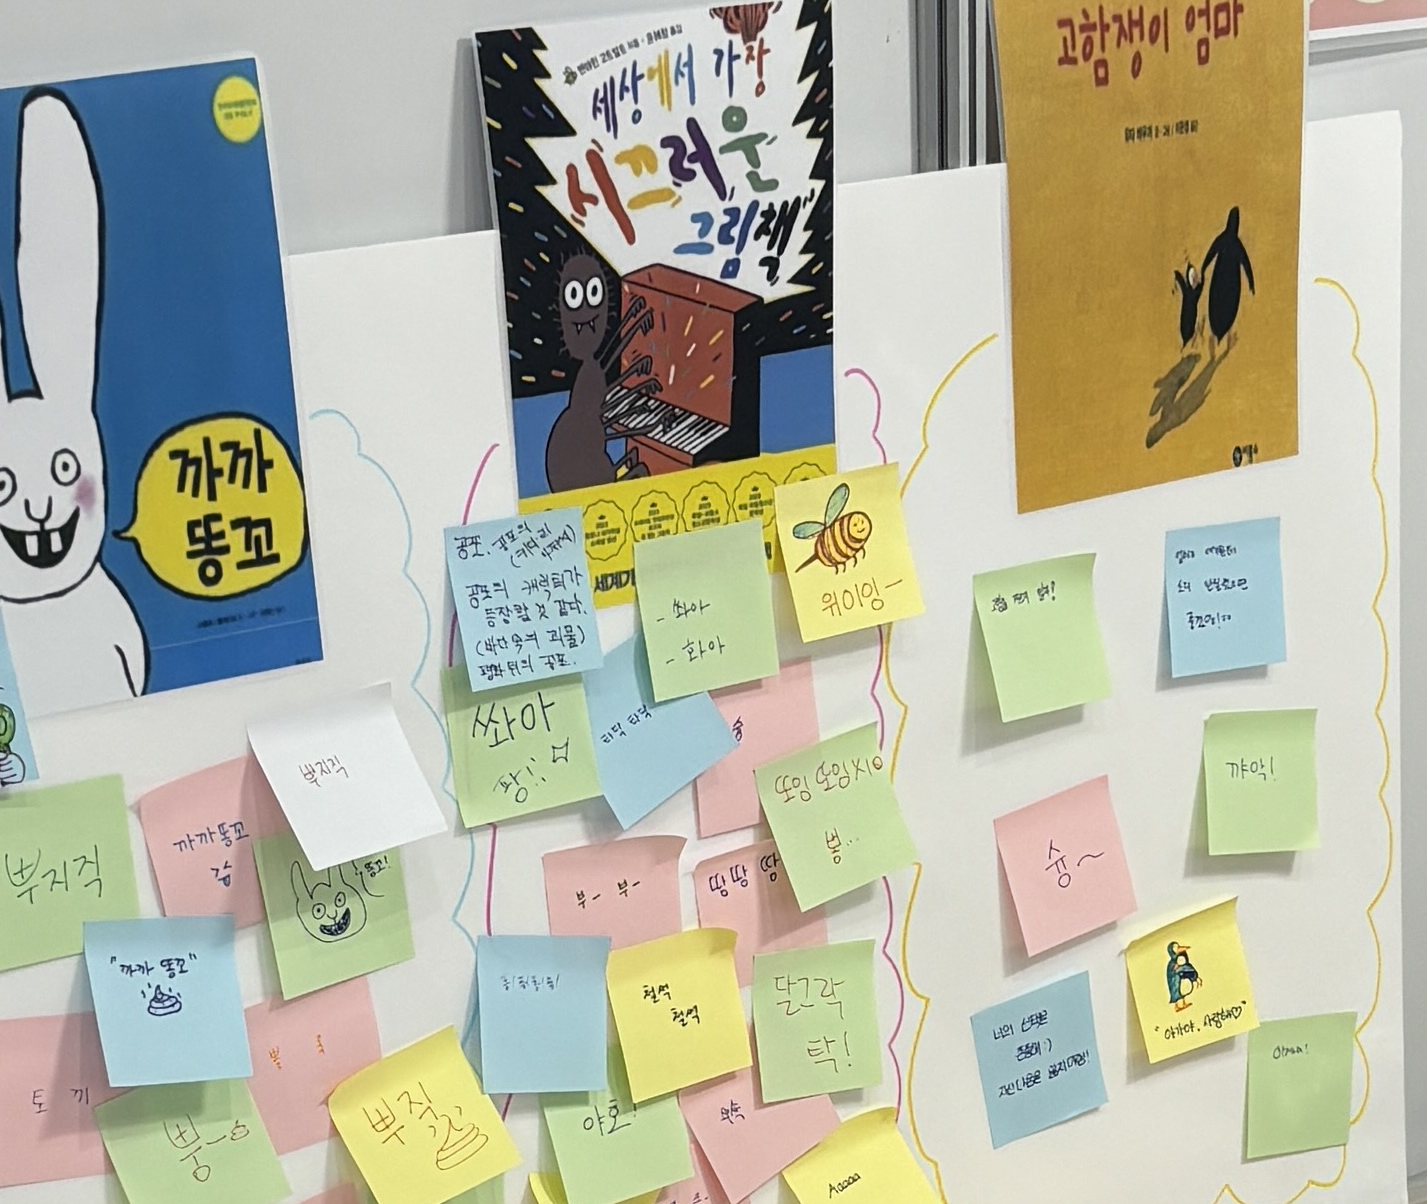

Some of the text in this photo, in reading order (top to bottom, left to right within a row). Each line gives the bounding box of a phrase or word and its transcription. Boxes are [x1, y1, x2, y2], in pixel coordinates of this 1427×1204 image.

[1056, 0, 1244, 87] 고함쟁이 엄마
[591, 36, 772, 140] 세상에서 가장
[565, 104, 782, 246] 시끄러운
[672, 195, 803, 283] 그림책
[168, 427, 275, 502] 까까
[185, 513, 281, 588] 똥꼬
[471, 690, 556, 748] 쏴아
[1225, 755, 1277, 782] 꺄악!
[773, 973, 845, 1021] 달그락
[807, 1030, 854, 1074] 탁!
